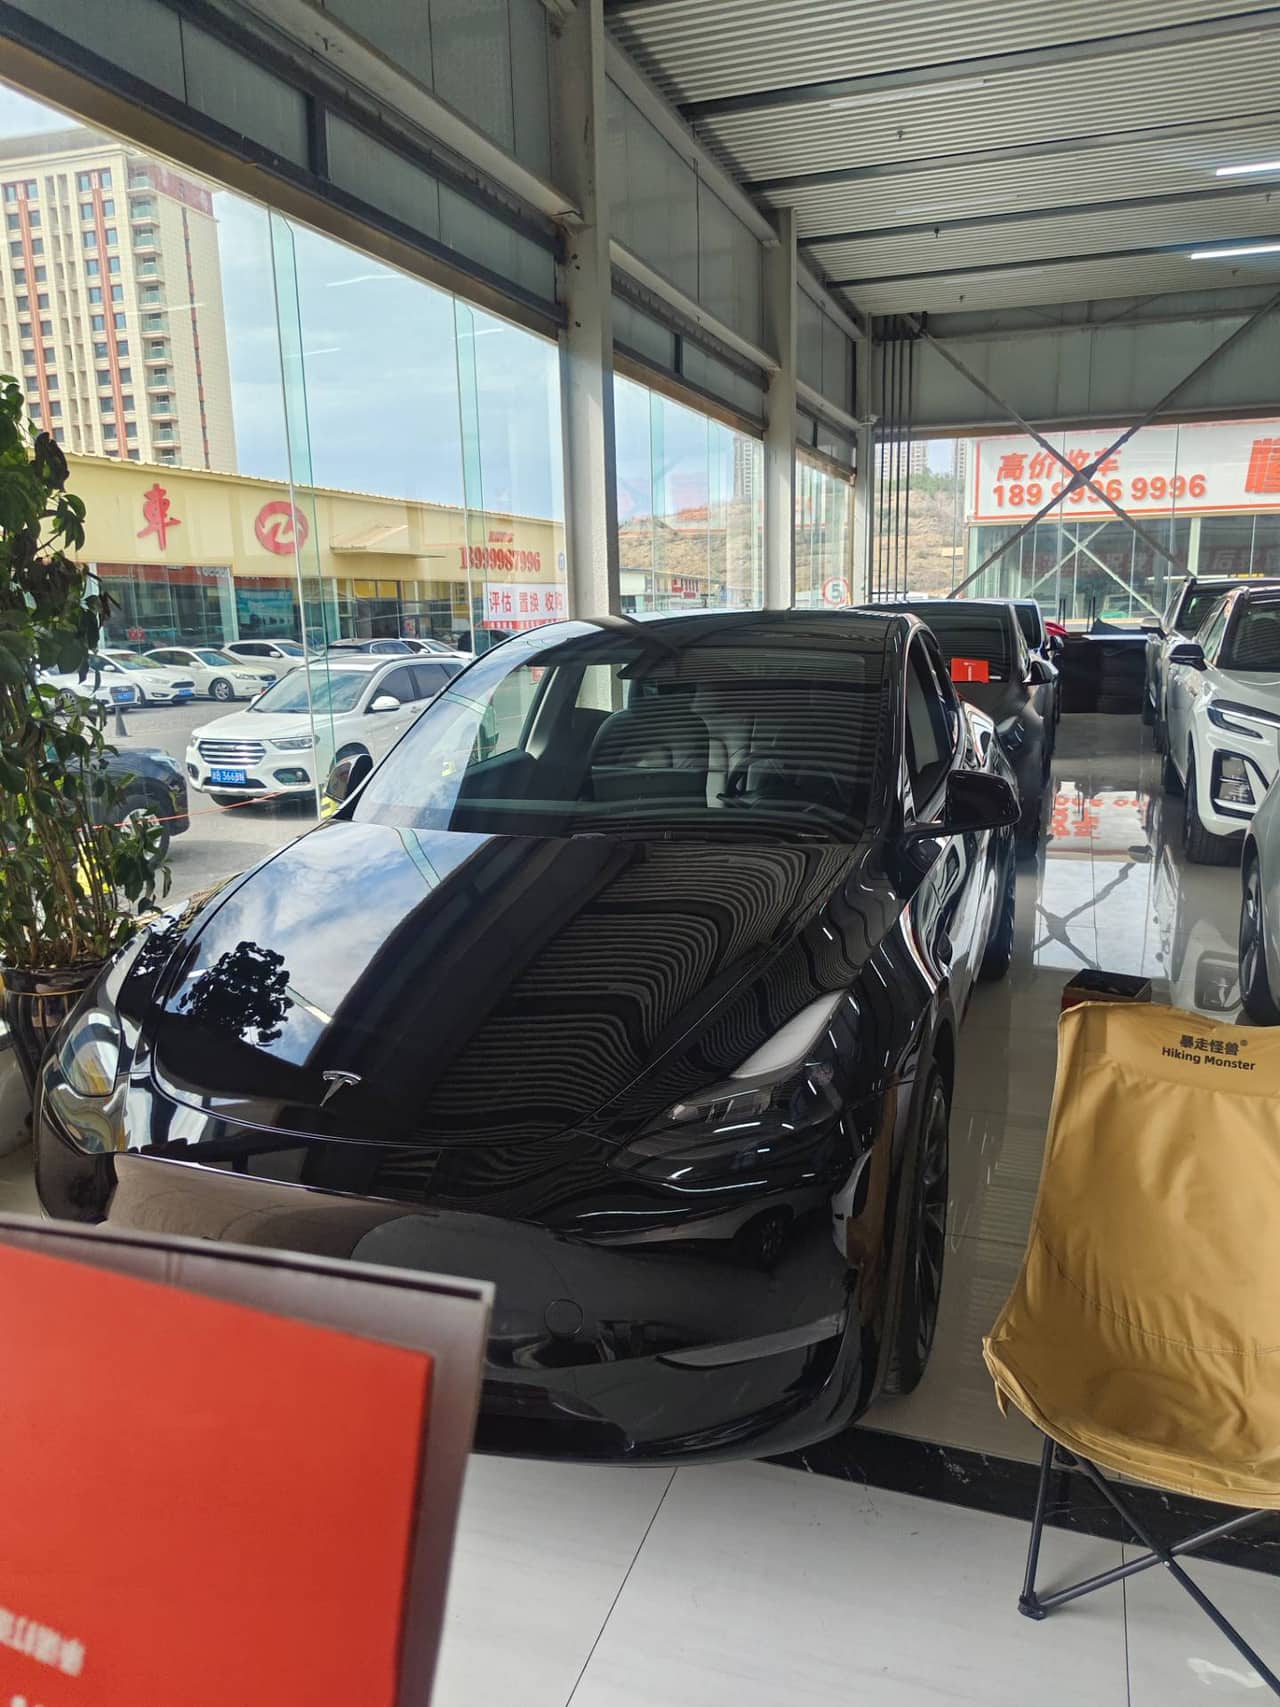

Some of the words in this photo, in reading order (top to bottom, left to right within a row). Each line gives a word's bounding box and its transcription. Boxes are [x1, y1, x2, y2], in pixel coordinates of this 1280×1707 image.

[997, 448, 1122, 481] 高价收车
[992, 483, 1043, 508] 189
[1131, 474, 1207, 501] 9996
[489, 592, 512, 613] 评估
[519, 592, 539, 612] 置换
[1162, 1046, 1201, 1064] Hiking
[1204, 1056, 1256, 1070] Monster
